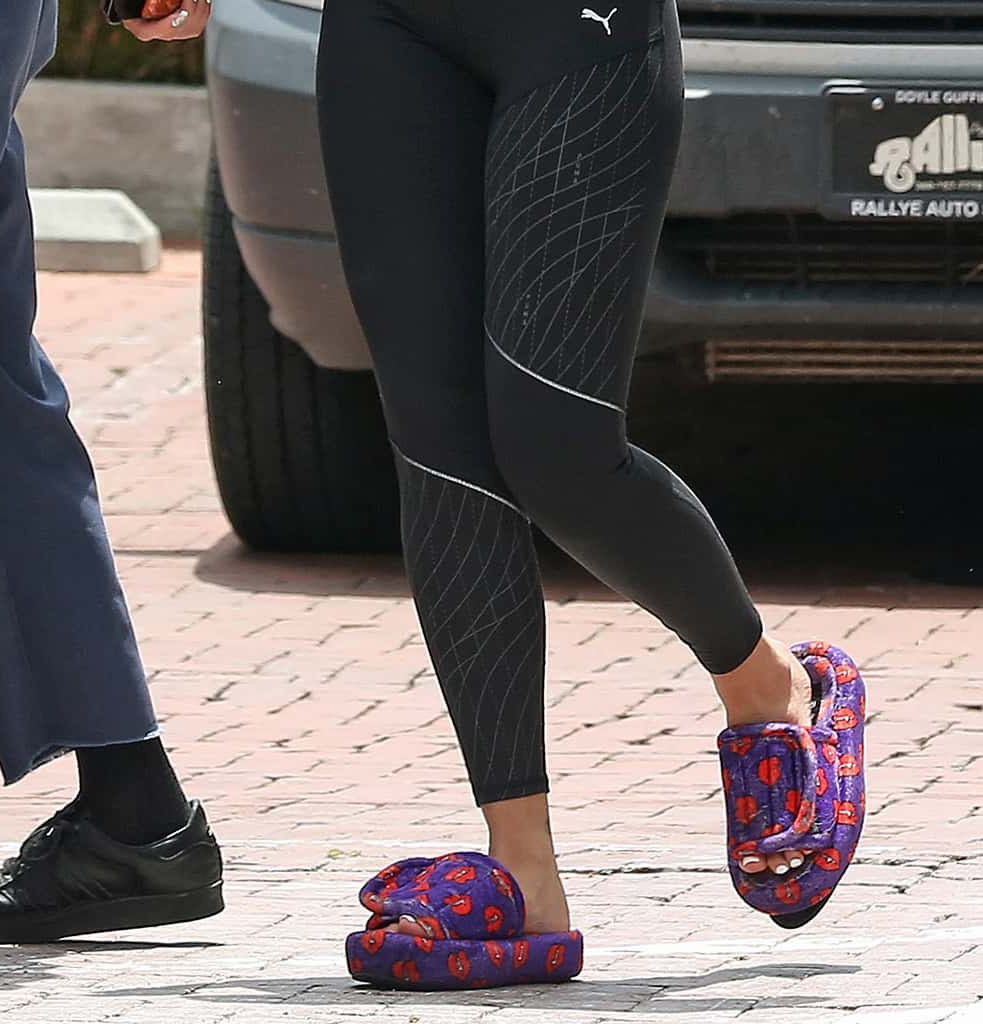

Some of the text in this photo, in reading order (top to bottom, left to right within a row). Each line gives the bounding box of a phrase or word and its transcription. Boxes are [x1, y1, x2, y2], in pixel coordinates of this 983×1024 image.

[895, 90, 941, 104] DOYLE
[851, 199, 923, 217] RALLYE
[925, 199, 979, 217] AUTO
